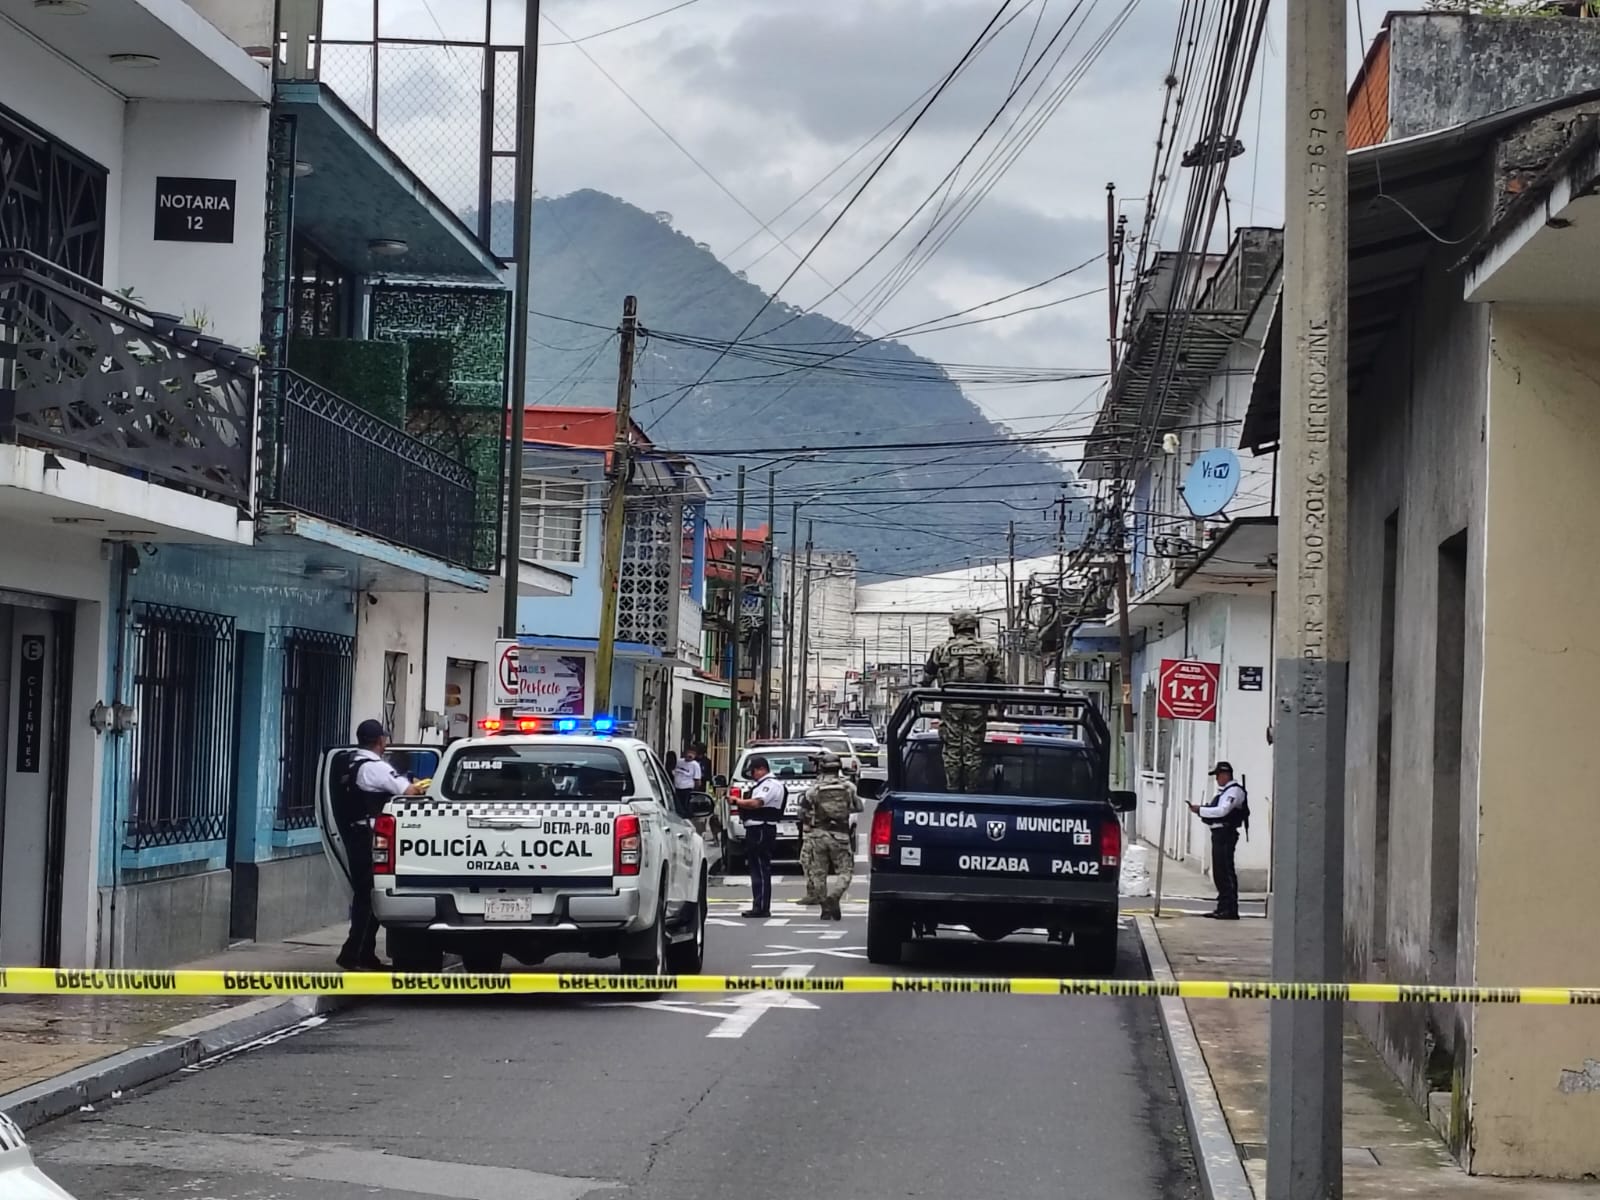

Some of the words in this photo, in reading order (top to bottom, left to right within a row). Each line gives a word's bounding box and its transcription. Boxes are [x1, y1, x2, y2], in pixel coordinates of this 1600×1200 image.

[160, 193, 230, 210] NOTARIA
[187, 215, 203, 230] 12
[26, 677, 35, 766] CLIENTES
[904, 811, 977, 828] POLICÍA
[1016, 816, 1091, 833] MUNICIPAL
[400, 835, 487, 857] POLICÍA
[521, 839, 592, 858] LOCAL
[467, 861, 520, 871] ORIZABA
[958, 856, 1030, 873] ORIZABA
[1052, 859, 1099, 875] PA-02
